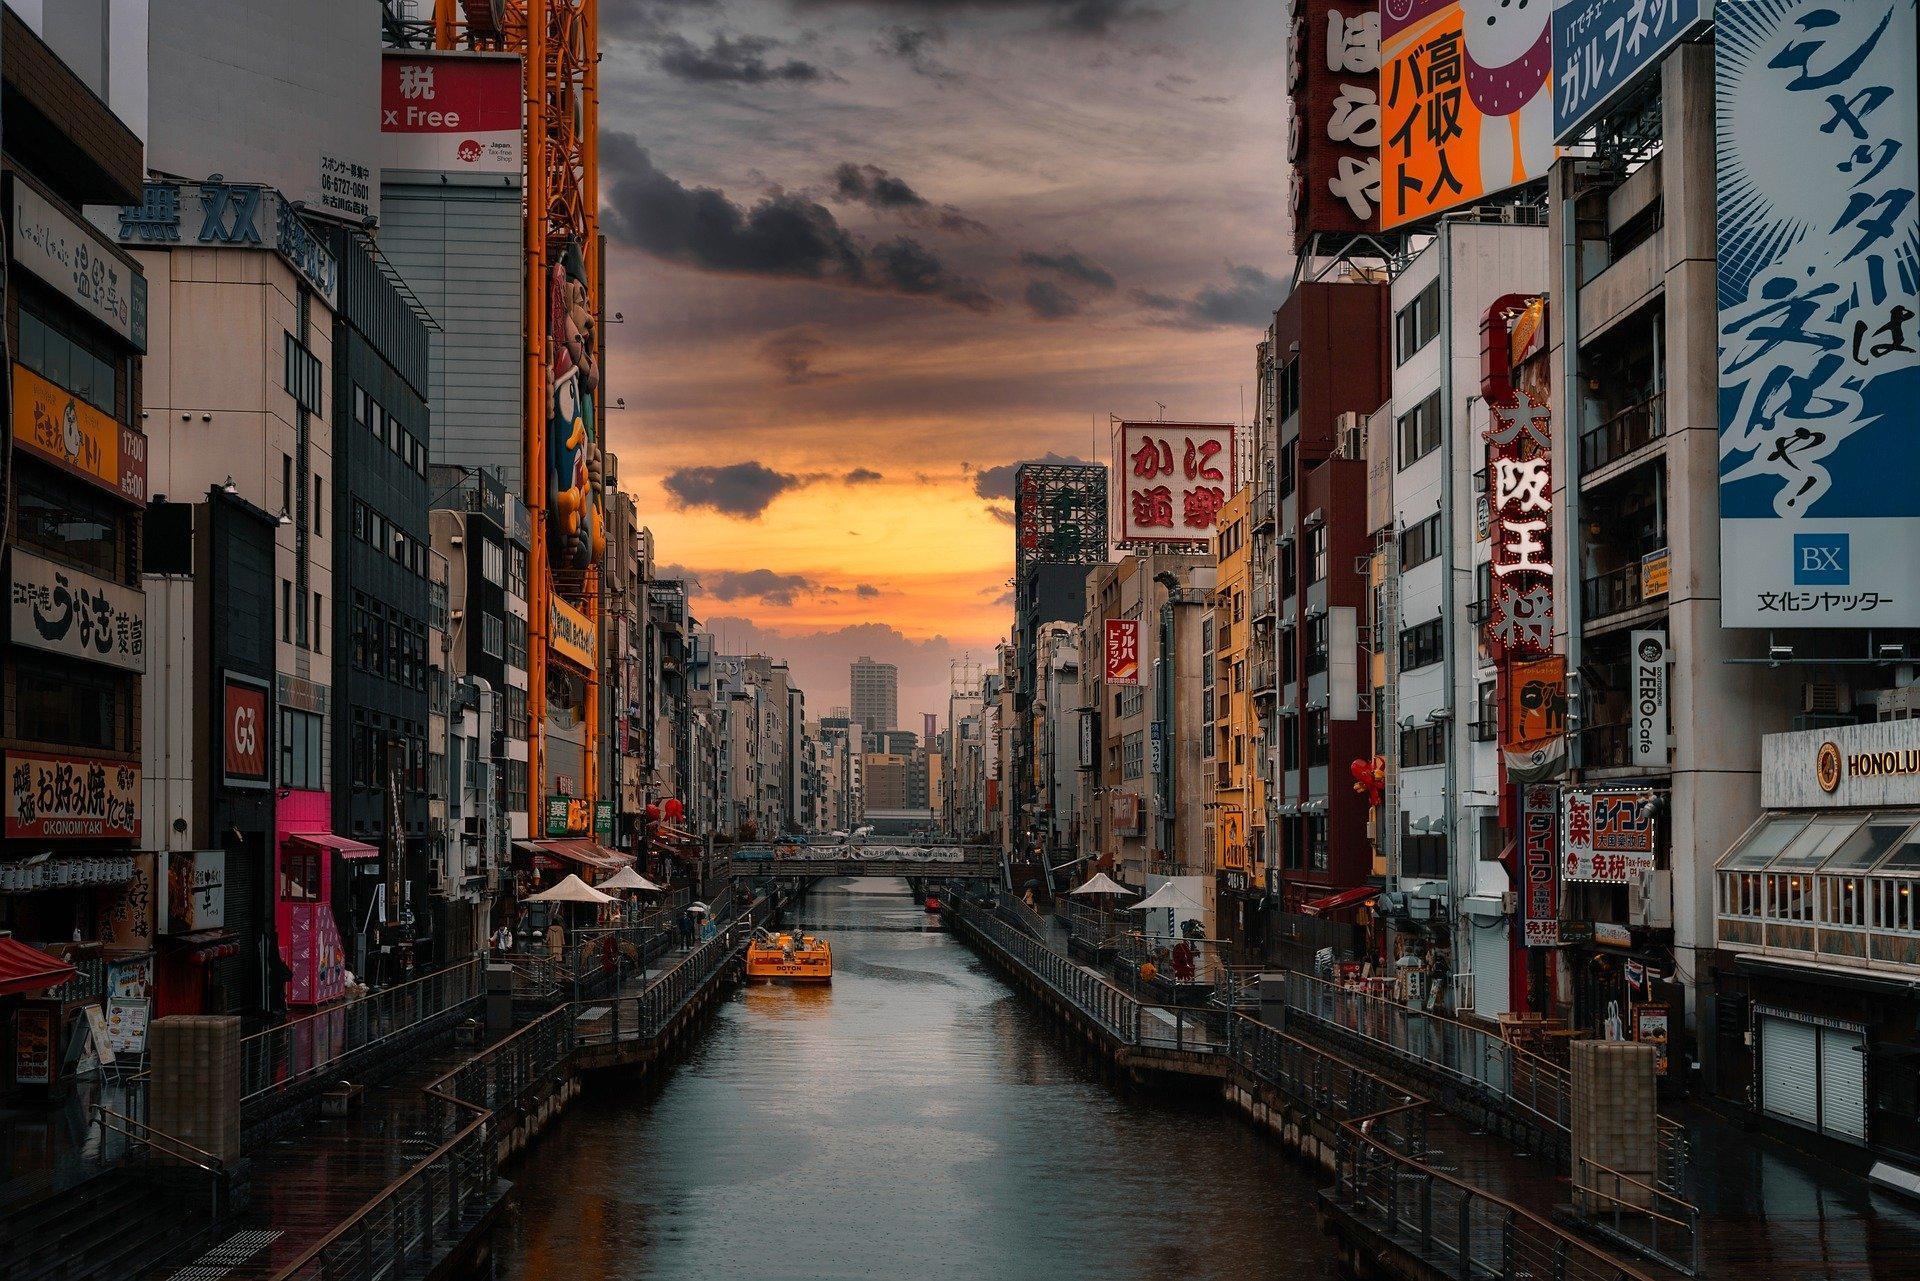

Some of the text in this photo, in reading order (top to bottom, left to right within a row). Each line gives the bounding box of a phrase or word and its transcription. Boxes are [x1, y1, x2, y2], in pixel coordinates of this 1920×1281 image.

[1566, 0, 1617, 48] ITでチェ
[406, 106, 460, 128] Free
[1388, 44, 1424, 216] バイト
[1426, 29, 1463, 205] 高収入
[321, 156, 370, 181] スポンサー募集中
[1131, 436, 1224, 481] かに
[1484, 388, 1552, 650] 大阪王将
[1801, 547, 1843, 571] BX
[1109, 629, 1121, 669] ドラッグ
[1121, 623, 1135, 660] ツルハ
[234, 705, 257, 756] G3
[1847, 750, 1920, 777] HONOLU
[36, 761, 106, 817] お好み焼
[43, 820, 103, 836] OKONOMIYAKI
[1595, 799, 1650, 832] ダイコク
[1529, 814, 1552, 883] ダイコク
[1591, 853, 1626, 880] 免税
[1626, 857, 1651, 868] Tax-Free
[1526, 921, 1557, 936] 免税
